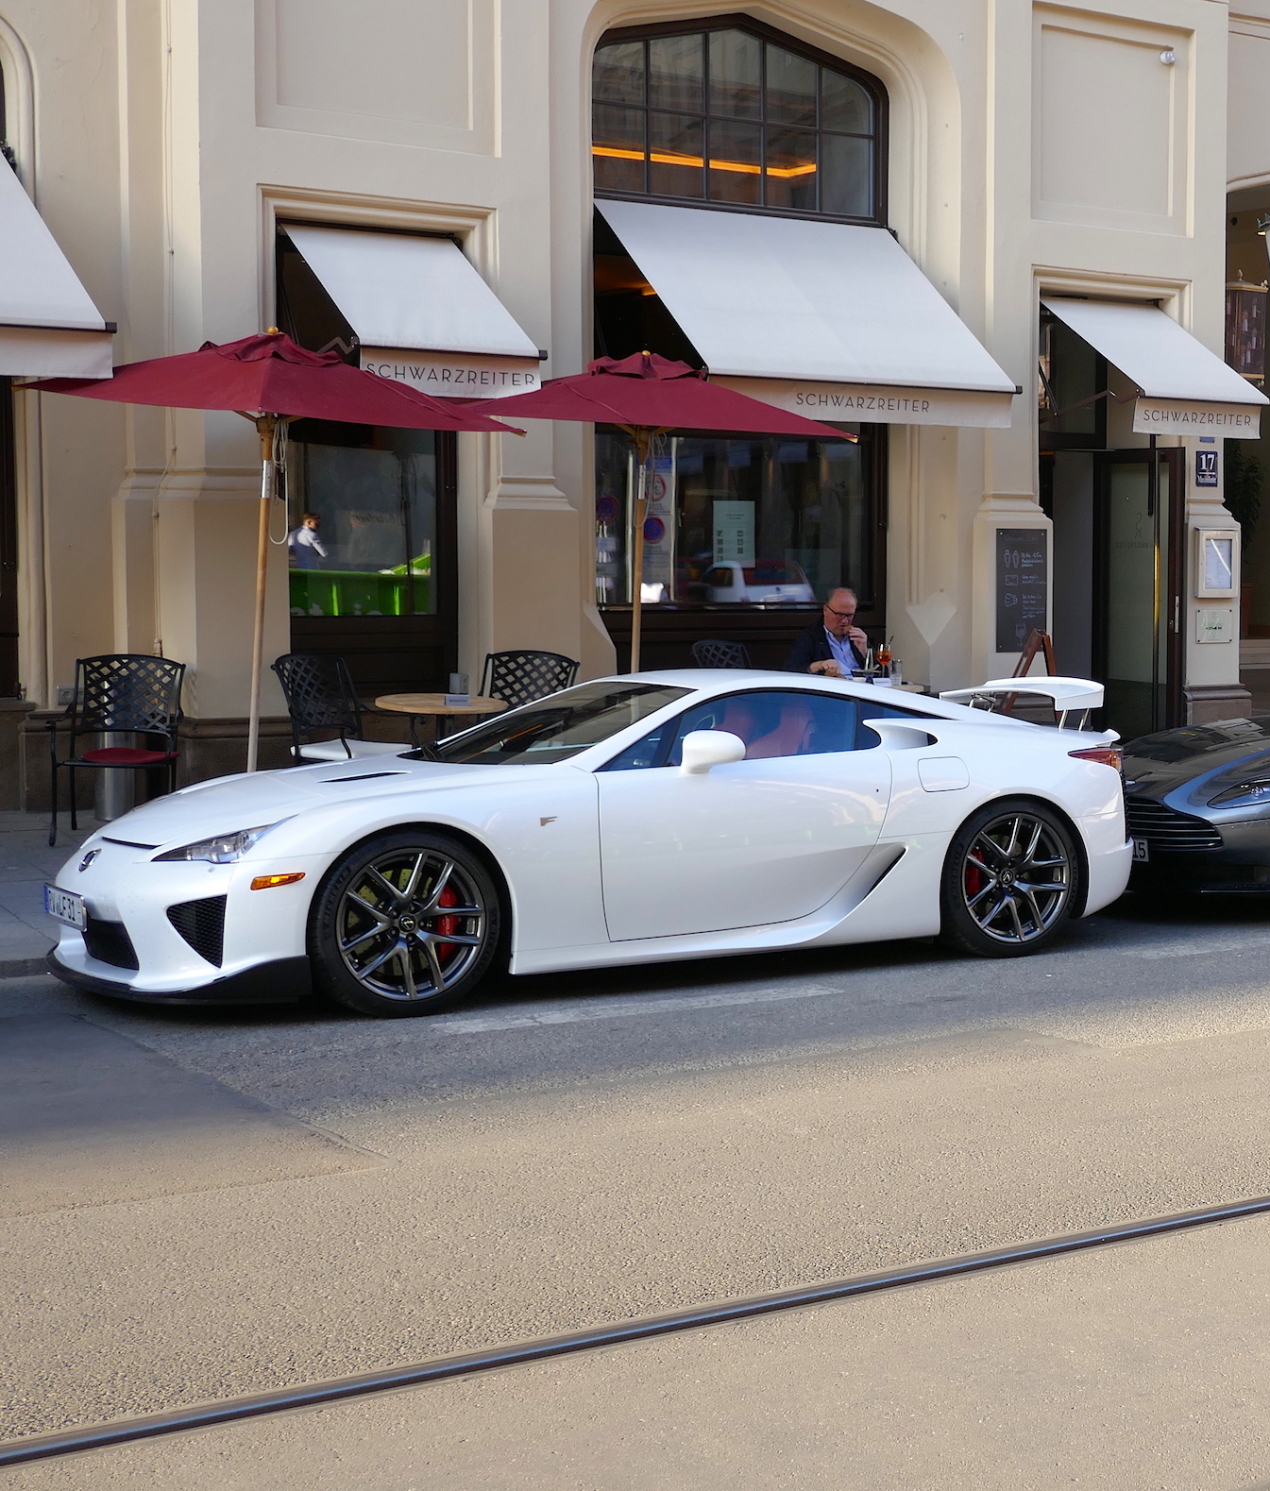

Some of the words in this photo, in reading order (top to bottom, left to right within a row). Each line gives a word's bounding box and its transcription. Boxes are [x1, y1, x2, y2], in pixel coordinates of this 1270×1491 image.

[366, 363, 535, 386] SCHWARZREITER
[796, 392, 930, 413] SCHWARZREITER
[1143, 409, 1251, 426] SCHWARZREITER
[1200, 453, 1215, 471] 17
